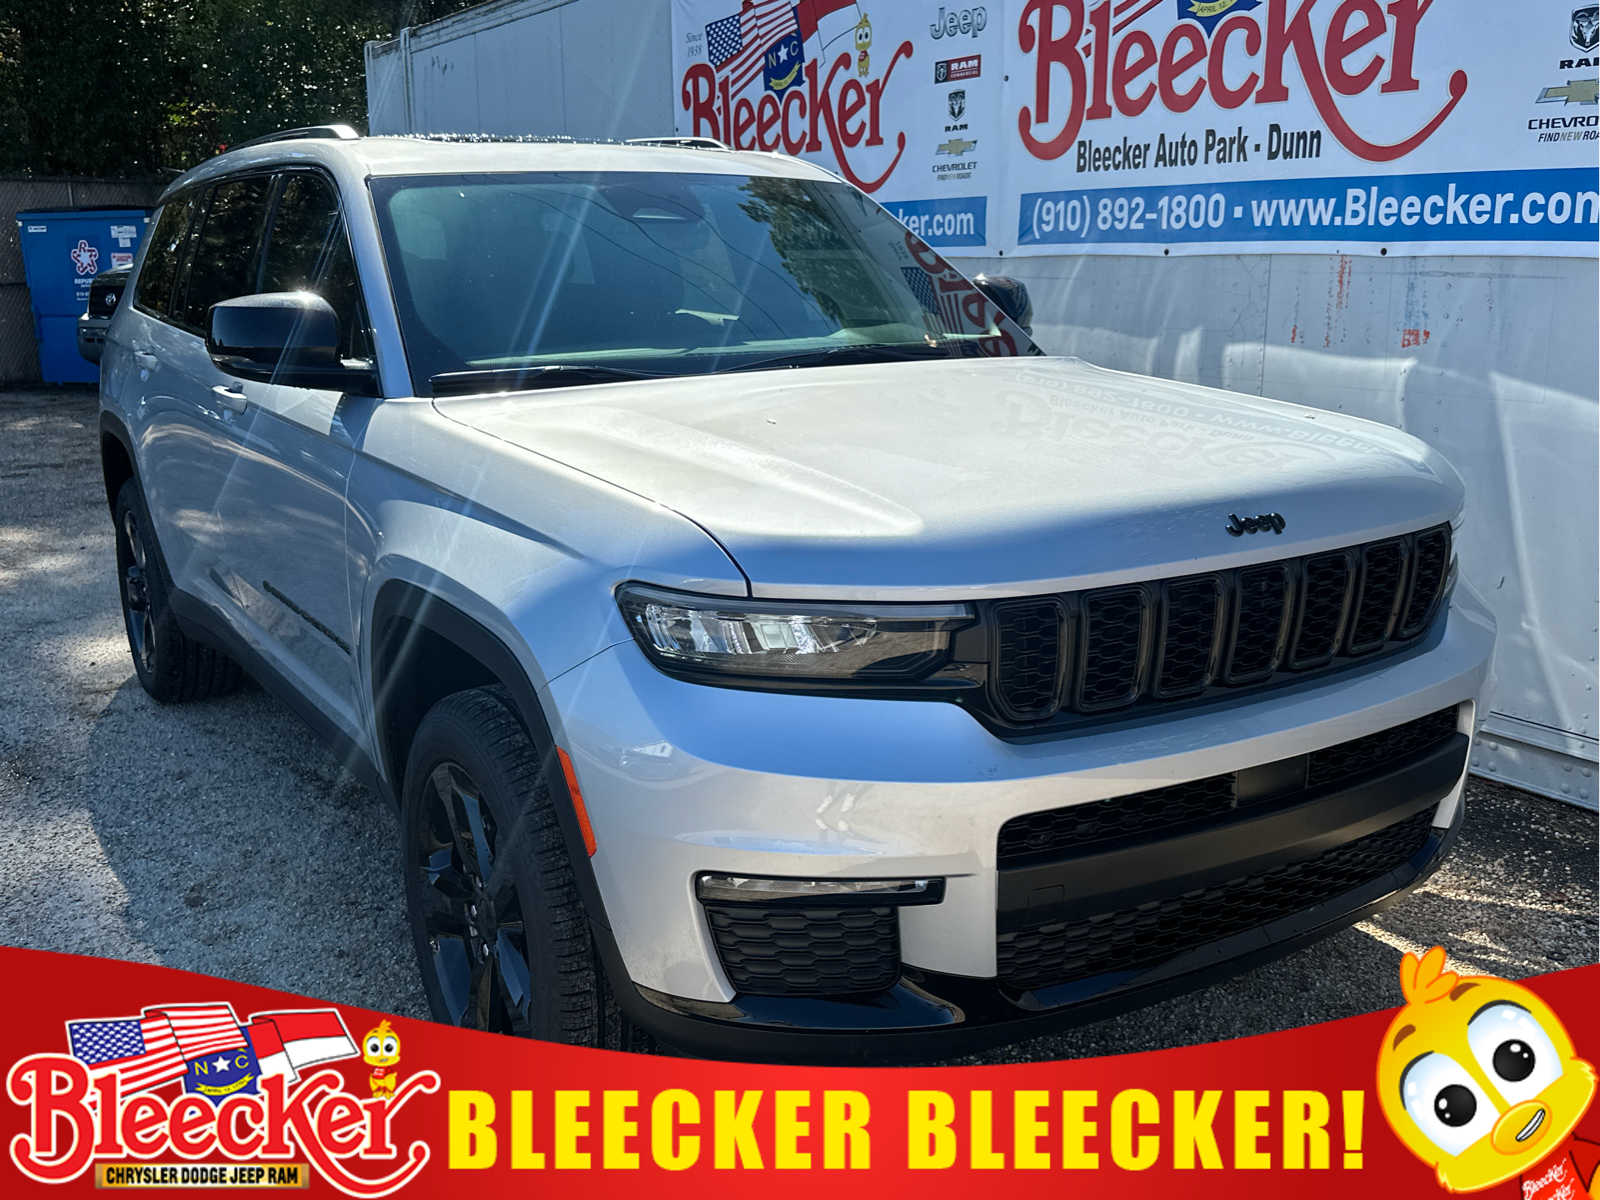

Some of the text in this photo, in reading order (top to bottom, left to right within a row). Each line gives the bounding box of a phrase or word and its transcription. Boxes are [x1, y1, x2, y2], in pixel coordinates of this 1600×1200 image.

[929, 6, 987, 40] Jeep
[951, 59, 978, 71] RAM
[1018, 0, 1467, 162] Bleecker
[682, 40, 914, 194] Bleecker
[944, 123, 968, 132] RAM
[1076, 123, 1322, 173] Bleecker Auto Park Dunn
[931, 161, 977, 173] CHEVROLET
[1033, 183, 1599, 239] (910) 892-1800 www.Bleecker.com
[1225, 512, 1286, 537] Jeep
